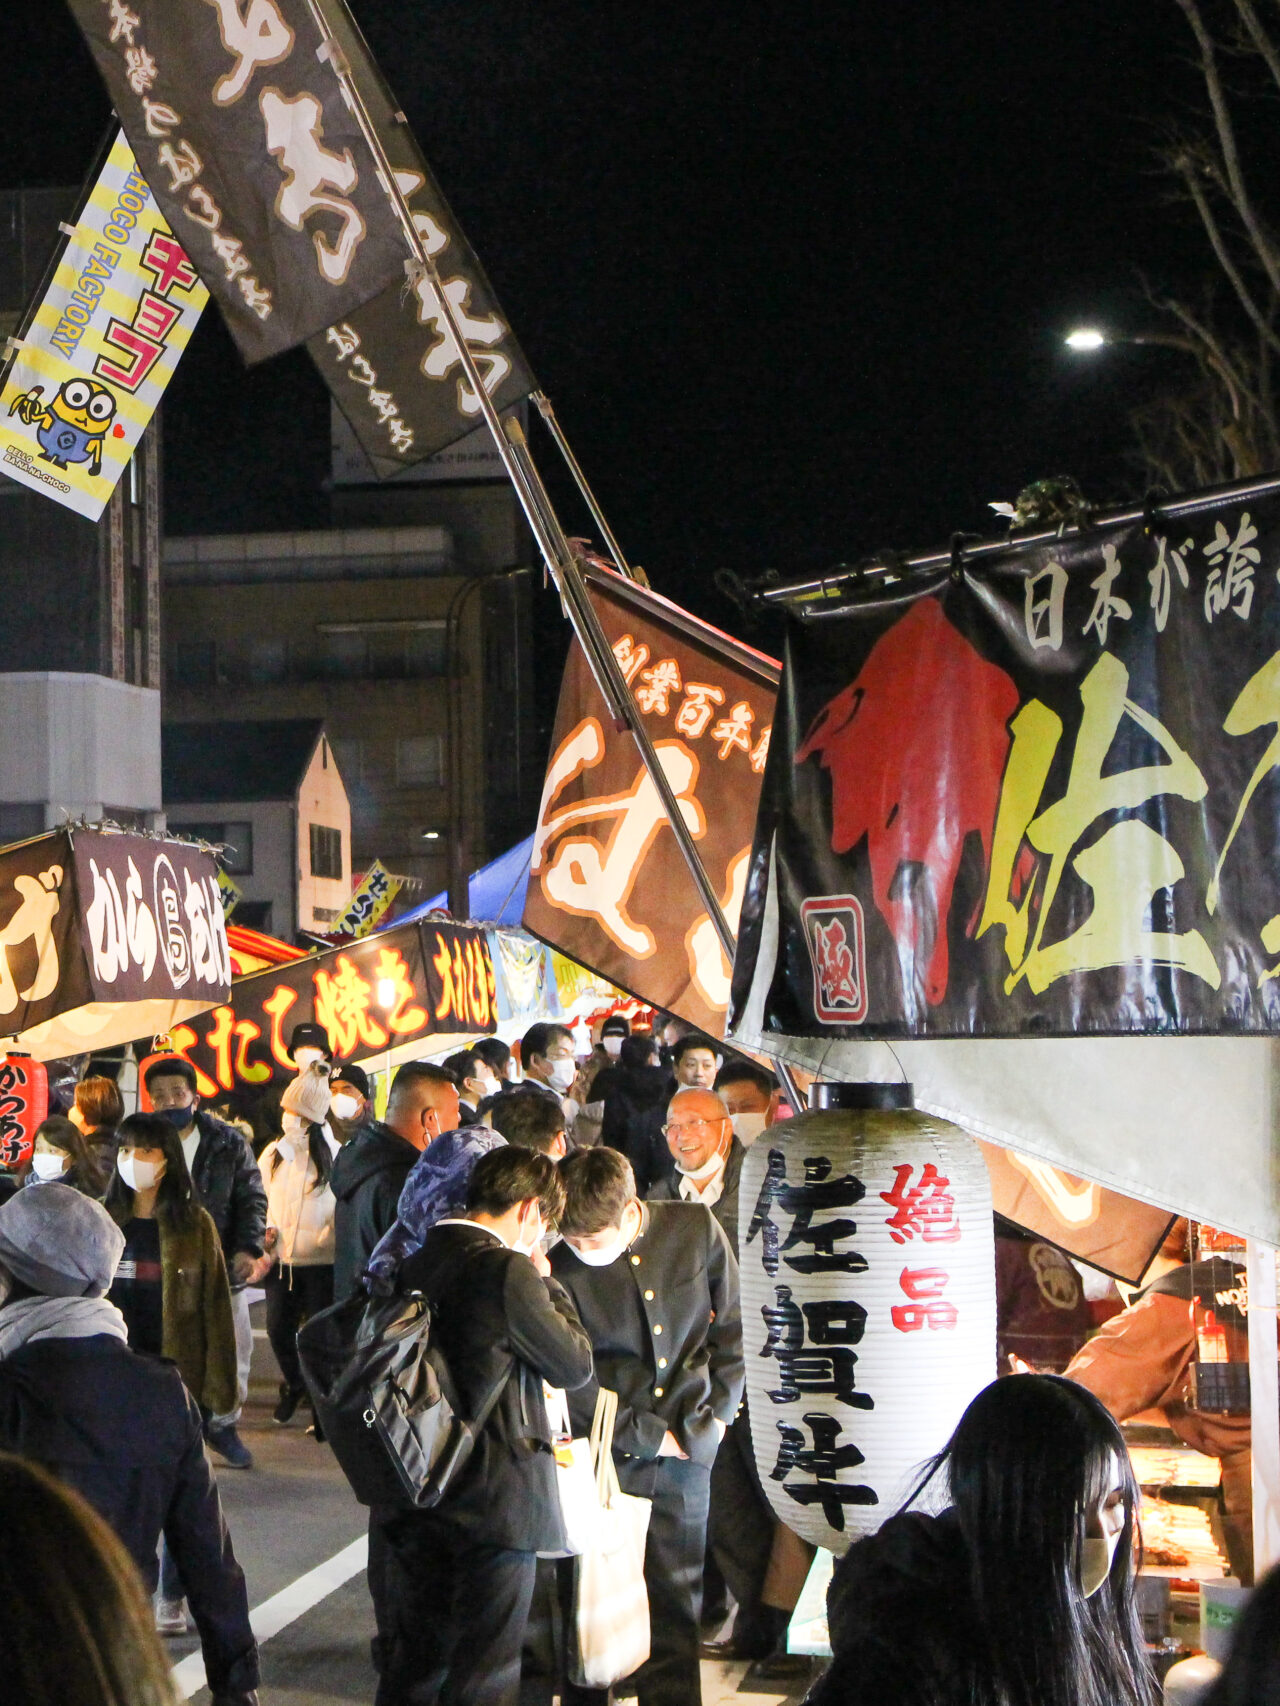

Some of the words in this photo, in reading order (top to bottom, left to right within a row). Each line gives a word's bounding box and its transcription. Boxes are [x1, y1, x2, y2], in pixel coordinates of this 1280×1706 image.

[103, 160, 151, 244] HOCO
[50, 242, 122, 361] FACTORY
[3, 453, 71, 494] BA-NA-NA-CHOCO
[6, 445, 34, 463] BELLO
[878, 1162, 962, 1334] 絶品
[746, 1149, 879, 1532] 佐賀牛
